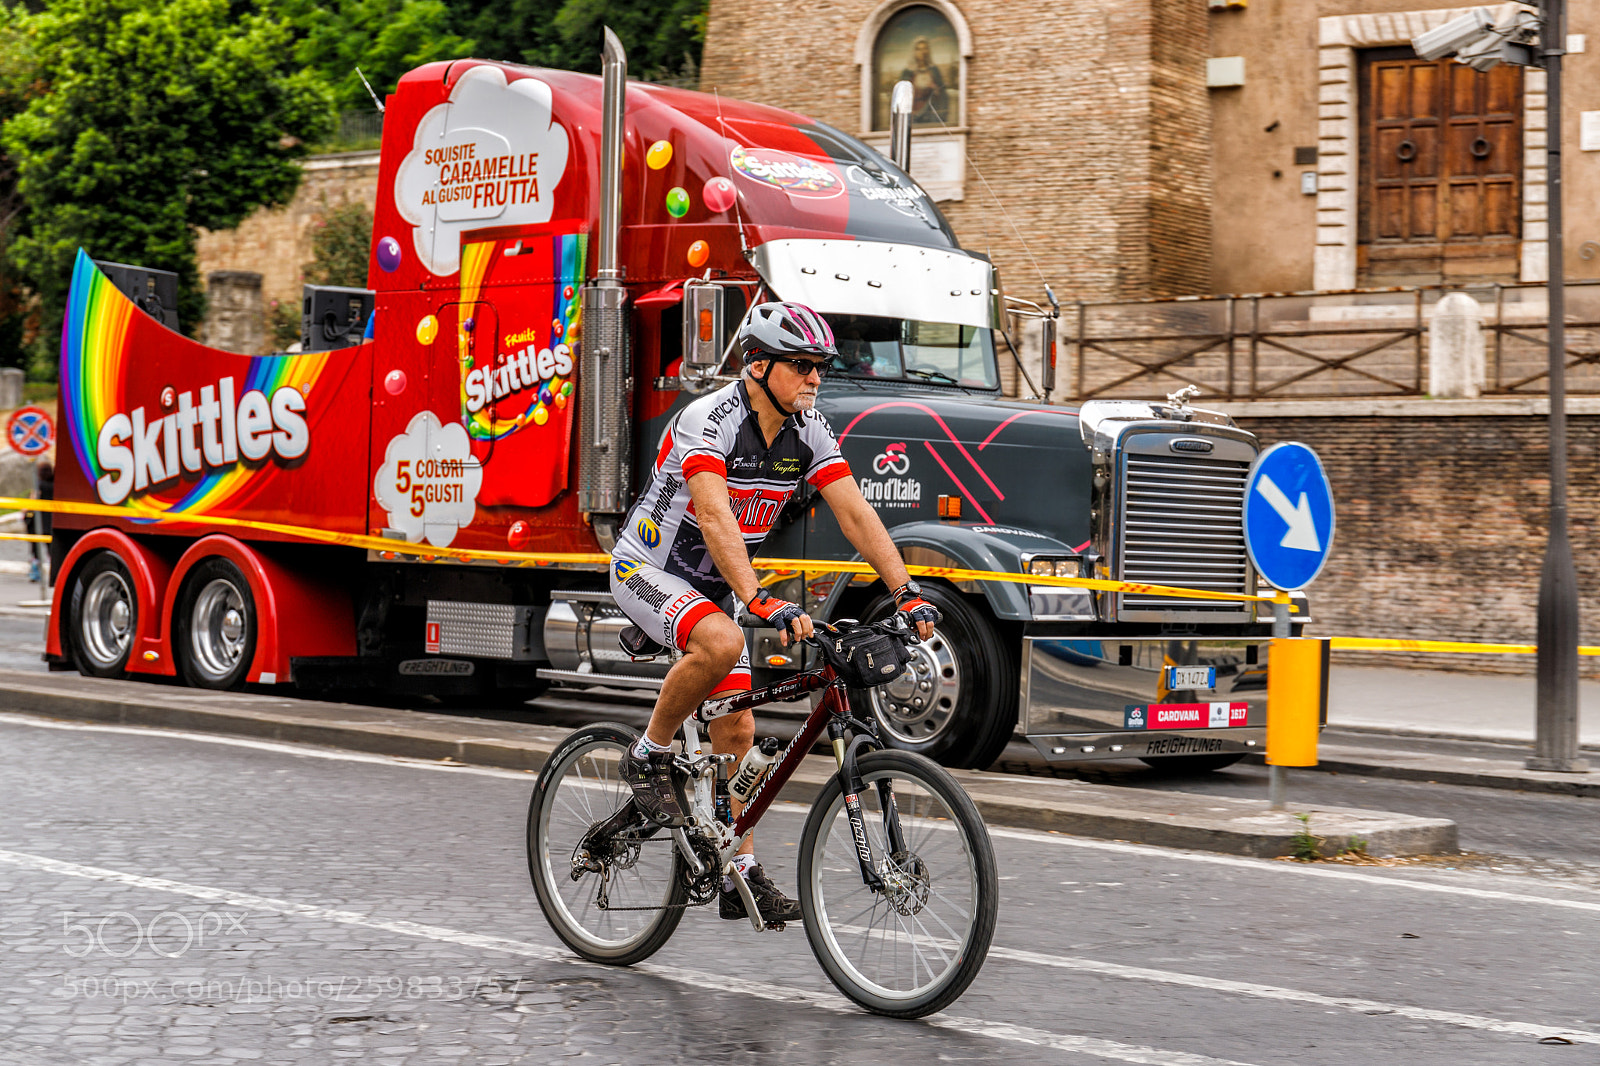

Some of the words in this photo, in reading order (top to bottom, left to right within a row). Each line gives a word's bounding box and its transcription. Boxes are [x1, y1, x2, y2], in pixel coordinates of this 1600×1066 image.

[425, 143, 476, 166] SQUISITE
[440, 153, 539, 186] CARAMELLE
[422, 190, 437, 205] AL
[438, 185, 472, 203] GUSTO
[473, 178, 540, 208] FRUTTA
[465, 344, 573, 413] Skittles
[96, 376, 310, 505] Skittles
[702, 427, 718, 440] IL
[395, 460, 411, 494] 5
[415, 458, 464, 478] COLORI
[860, 477, 883, 501] Giro
[884, 477, 921, 501] d'Italia
[410, 484, 425, 518] 5
[425, 484, 463, 503] GUSTI
[650, 472, 680, 528] europlanet
[972, 526, 1047, 540] CAROVANA
[625, 573, 673, 610] europlanet
[403, 660, 470, 673] FREIGHTLINER
[1157, 710, 1200, 722] CAROVANA
[1230, 709, 1247, 720] 1617
[1146, 738, 1223, 755] FREIGHTLINER
[733, 761, 761, 796] BIKE
